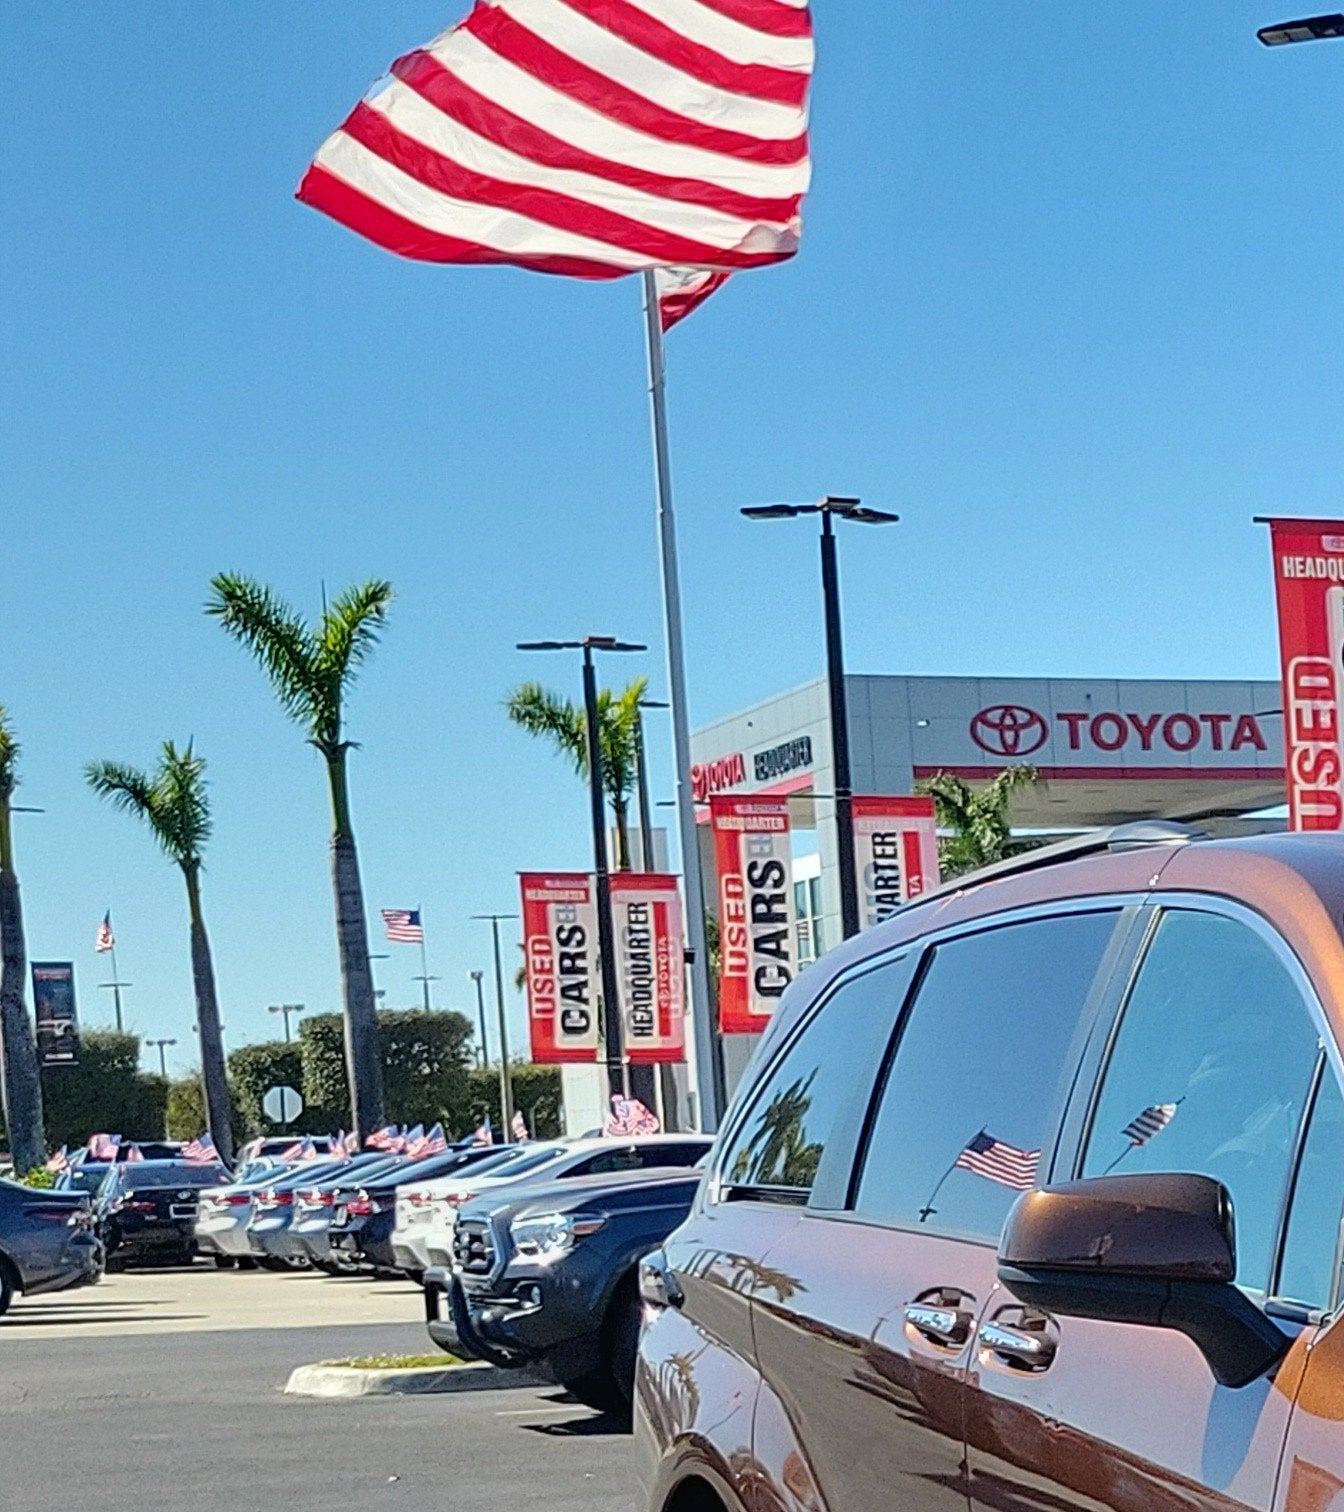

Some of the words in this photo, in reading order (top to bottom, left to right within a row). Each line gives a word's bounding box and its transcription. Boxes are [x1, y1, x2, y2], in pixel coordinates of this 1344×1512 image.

[1056, 712, 1268, 752] TOYOTA
[1289, 657, 1342, 830] USED
[529, 936, 556, 1019] USED
[556, 925, 591, 1035] CARS
[628, 902, 655, 1037] HEADQUARTER
[722, 875, 748, 977] USED
[748, 860, 792, 998] CARS
